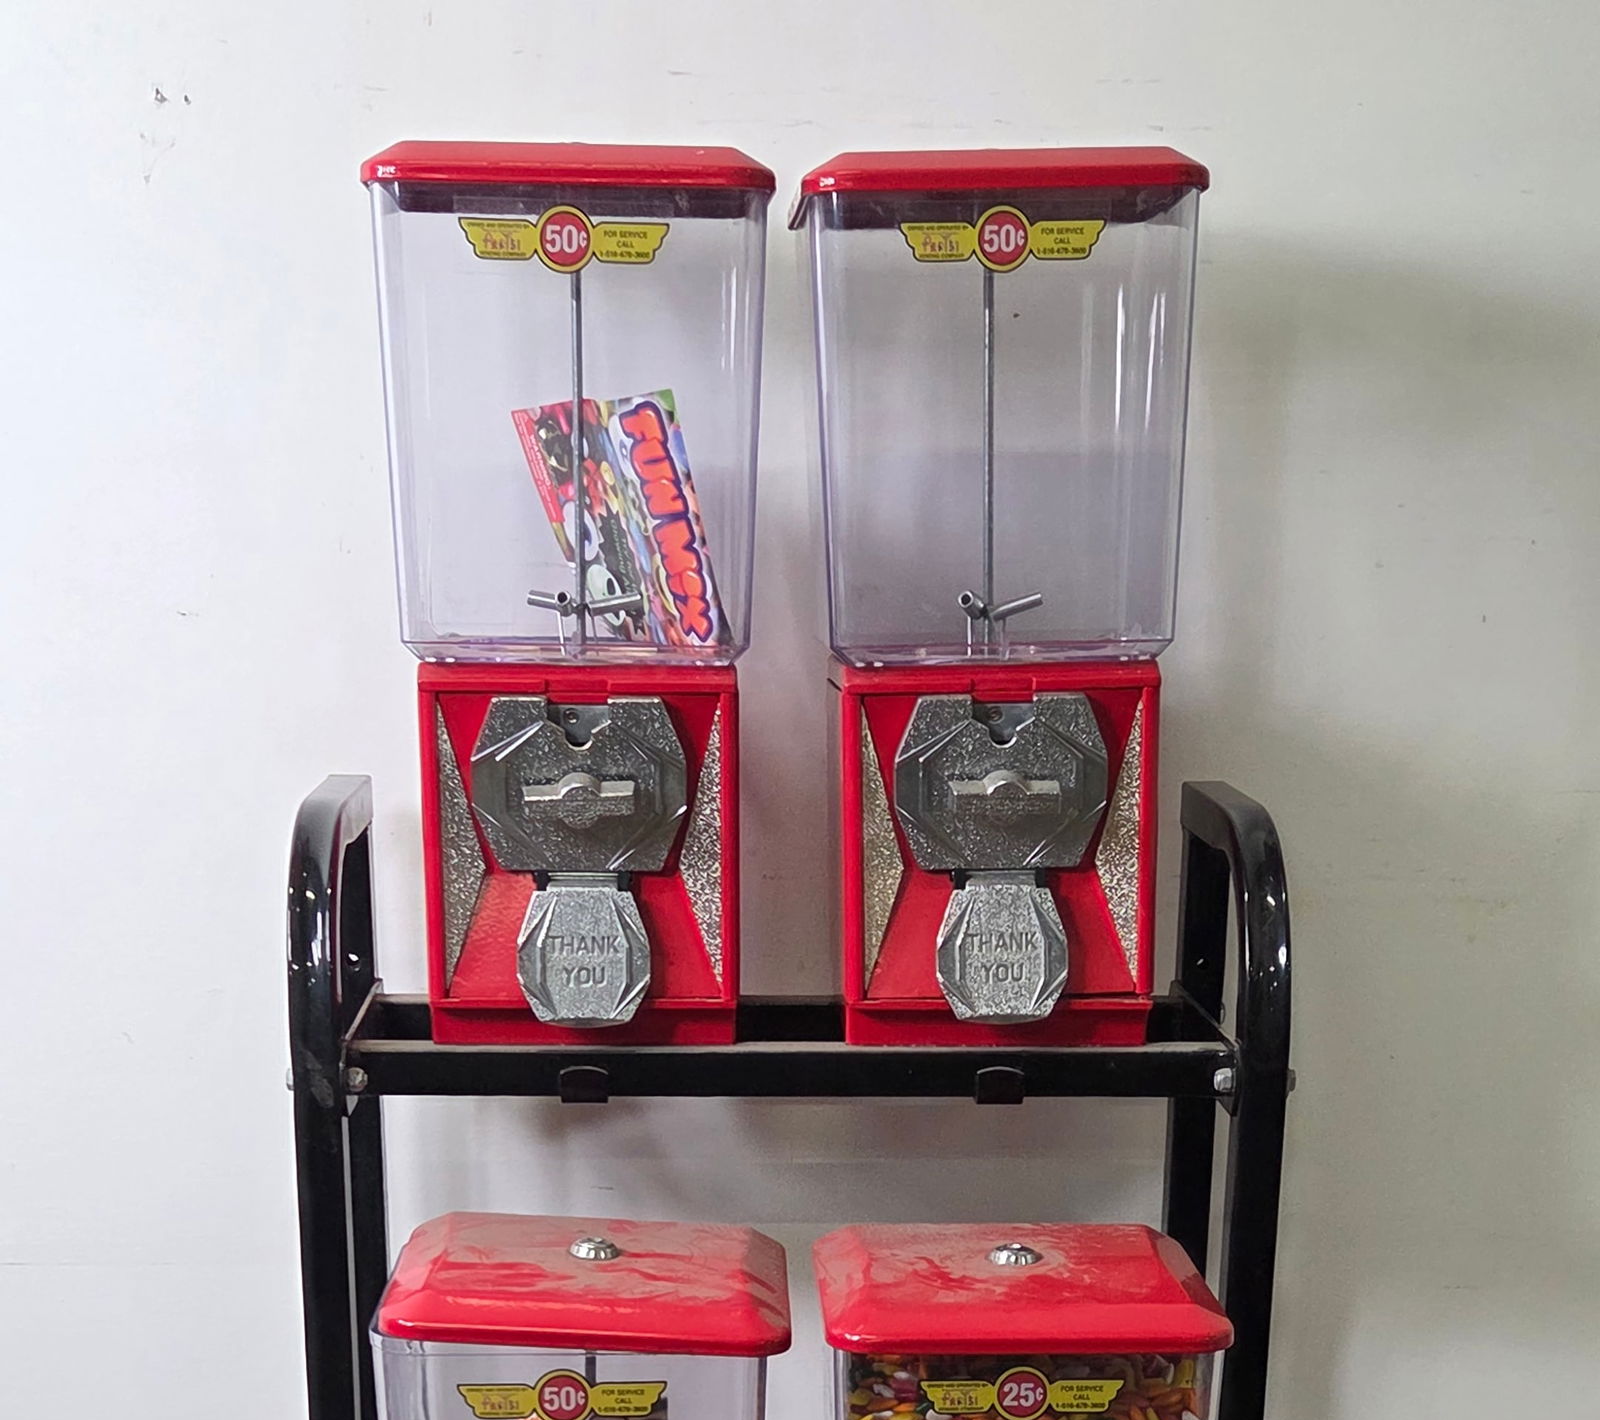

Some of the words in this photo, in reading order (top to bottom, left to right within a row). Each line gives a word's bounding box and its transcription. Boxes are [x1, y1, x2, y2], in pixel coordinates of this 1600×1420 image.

[545, 224, 588, 254] 50¢
[603, 230, 617, 239] FOR
[619, 231, 648, 240] SERVICE
[983, 224, 1025, 253] 50¢
[1041, 227, 1055, 236] FOR
[1056, 227, 1085, 236] SERVICE
[1054, 236, 1071, 245] CALL
[616, 239, 634, 249] CALL
[620, 402, 689, 518] FUN
[548, 935, 621, 956] THANK
[966, 932, 1039, 951] THANK
[562, 966, 606, 988] YOU
[981, 962, 1025, 982] YOU
[543, 1386, 586, 1411] 50¢
[601, 1388, 615, 1396] FOR
[617, 1388, 646, 1396] SERVICE
[1002, 1383, 1043, 1407] 25¢
[1060, 1385, 1074, 1393] FOR
[1075, 1385, 1104, 1393] SERVICE
[1073, 1393, 1090, 1401] CALL
